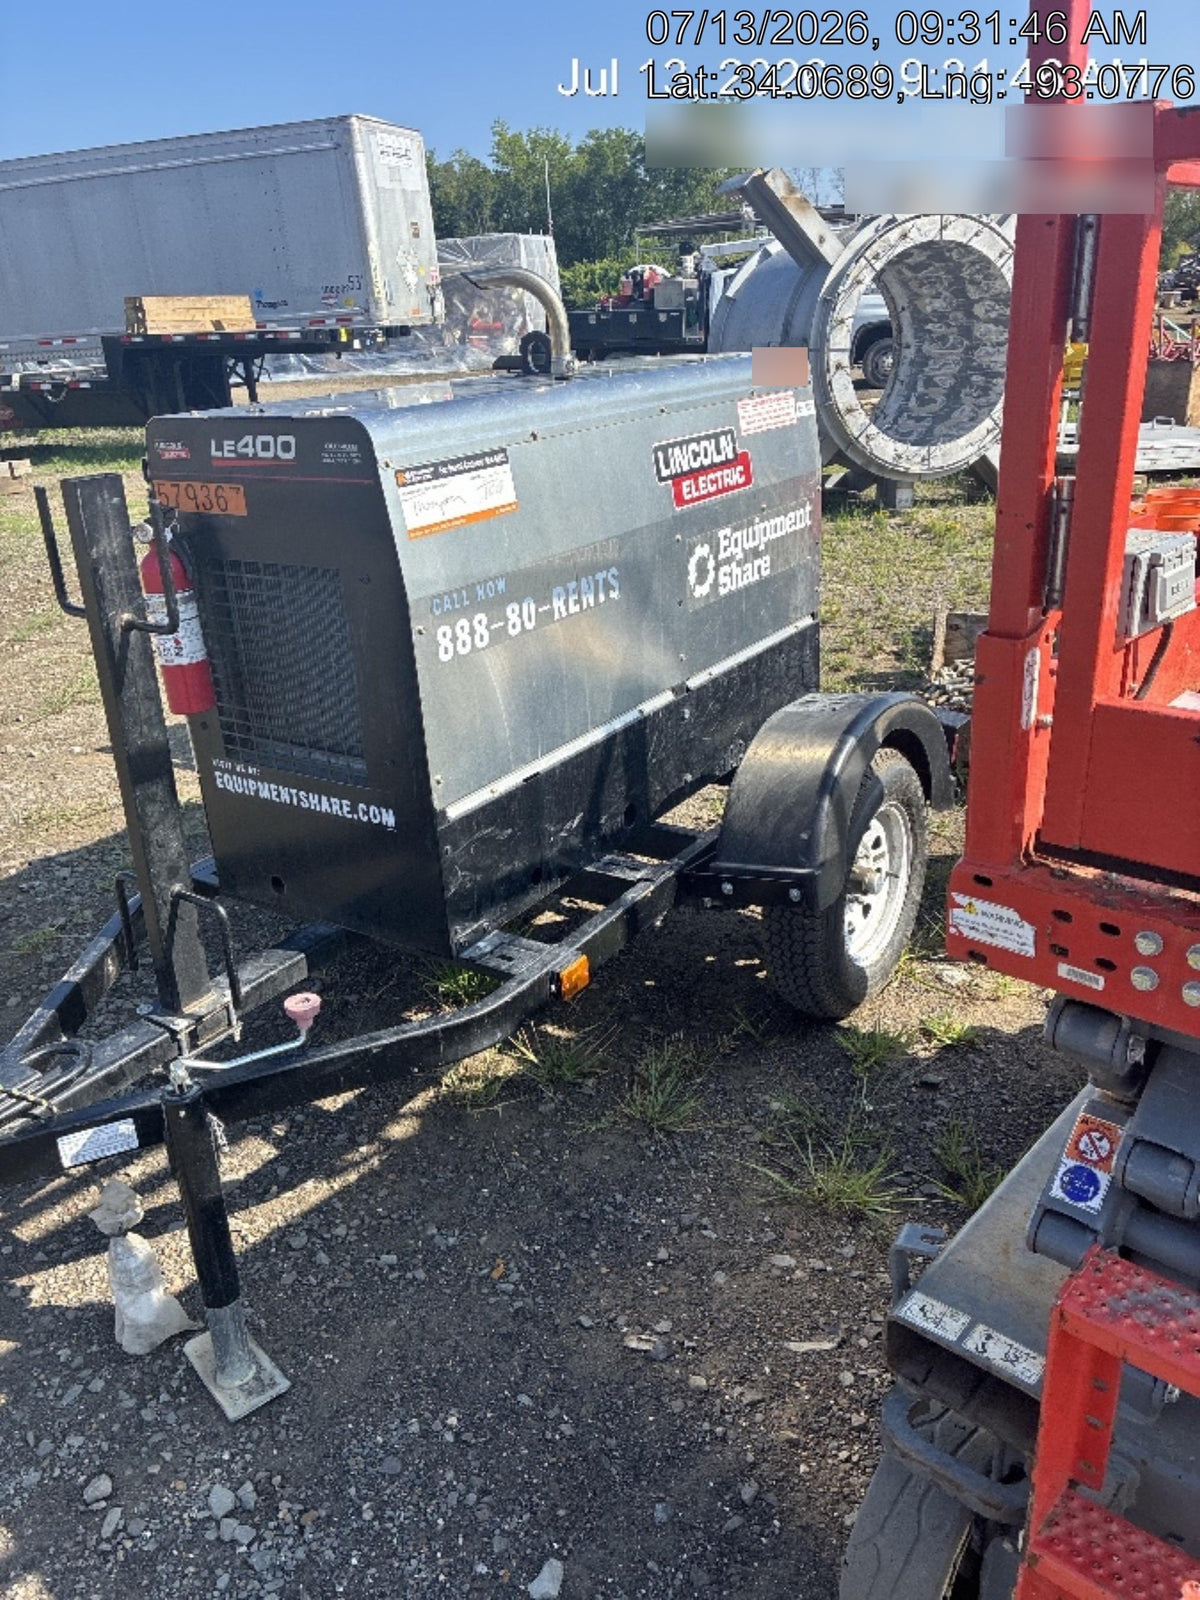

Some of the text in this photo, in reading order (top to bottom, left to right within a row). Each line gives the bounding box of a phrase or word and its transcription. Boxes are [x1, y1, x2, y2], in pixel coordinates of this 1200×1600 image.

[210, 434, 297, 460] LE400
[656, 434, 736, 477] LINCOLN
[681, 466, 746, 501] ELECTRIC
[717, 502, 813, 561] Equipment
[432, 577, 507, 616] CALL NOW
[717, 555, 772, 596] Share
[436, 566, 621, 662] 888-80-RENTS
[213, 771, 397, 829] EQUIPMENTSHARE.COM
